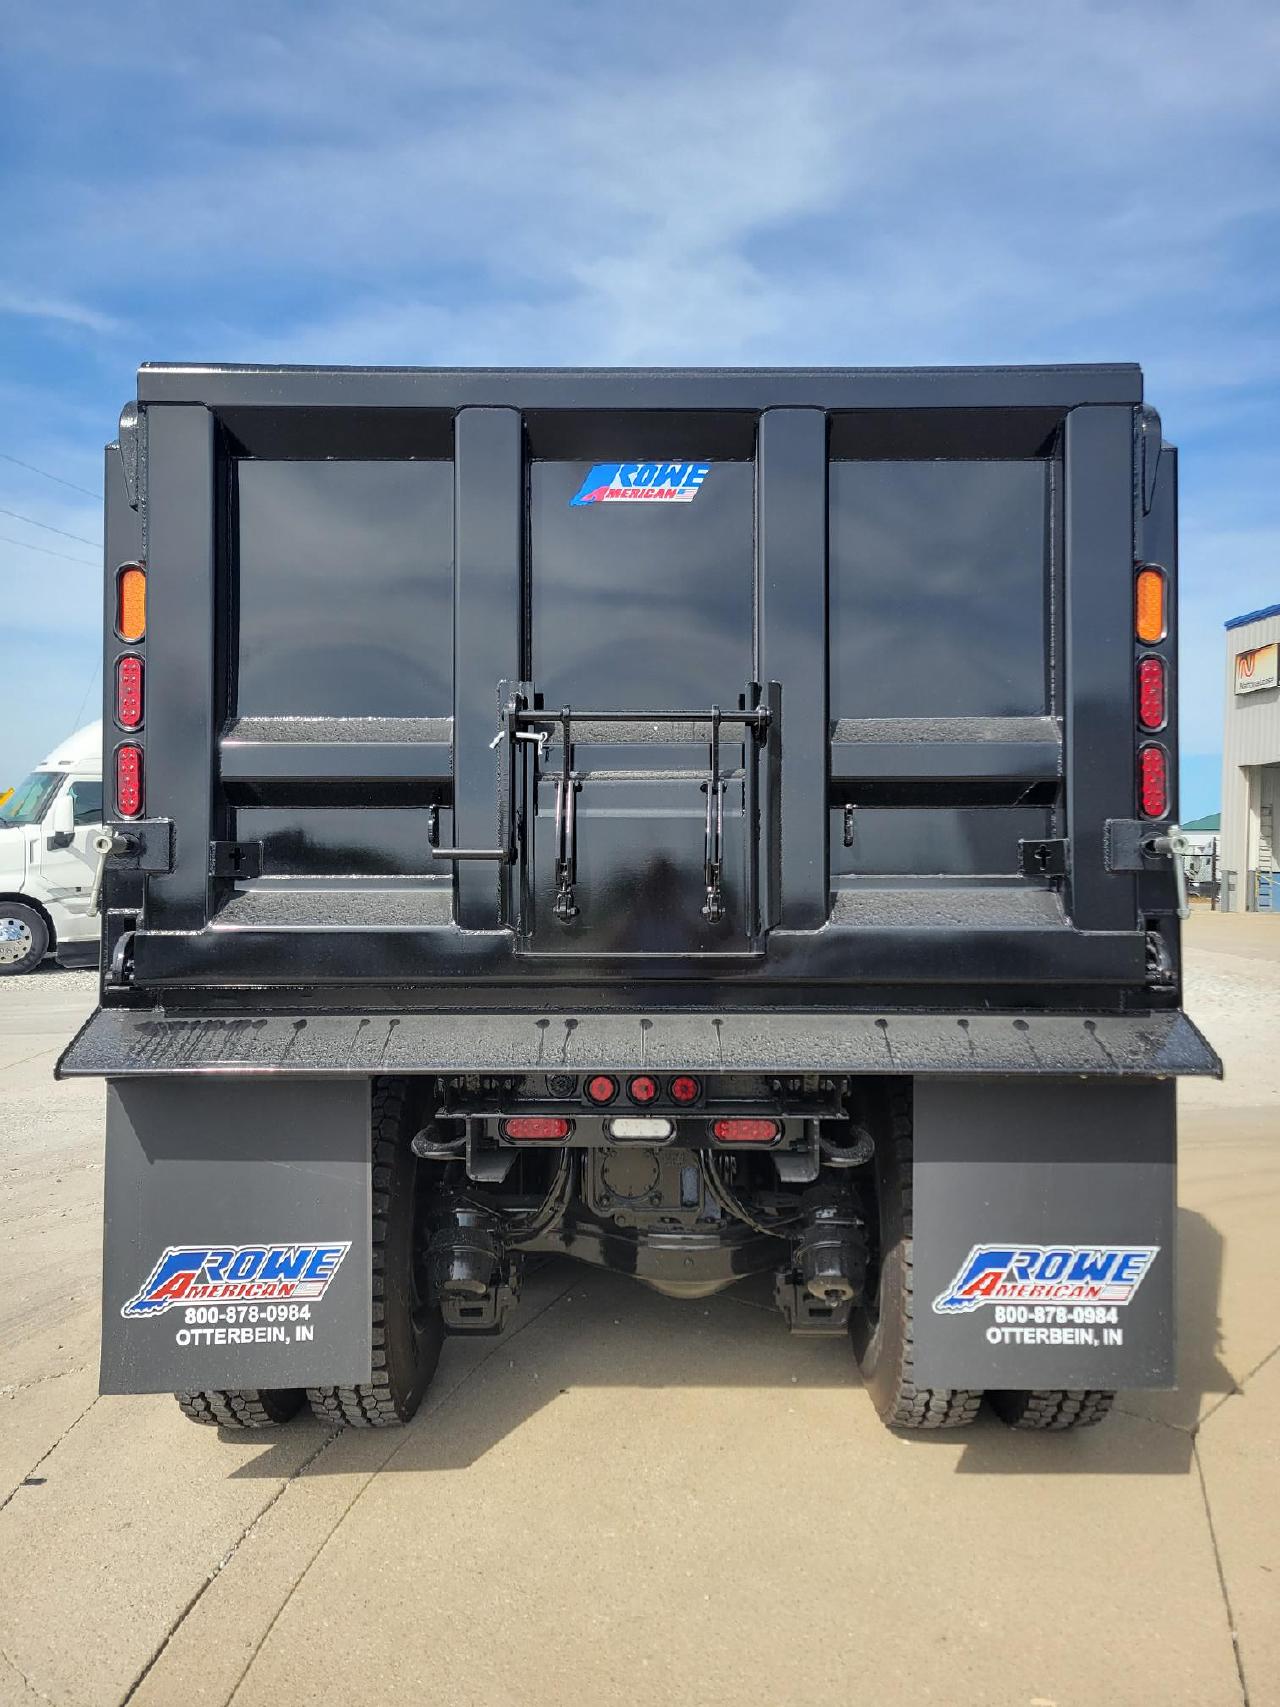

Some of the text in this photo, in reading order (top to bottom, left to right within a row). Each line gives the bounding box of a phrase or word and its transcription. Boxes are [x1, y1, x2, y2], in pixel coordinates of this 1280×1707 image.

[612, 463, 710, 488] ROWE
[581, 486, 677, 502] AMERICAN
[198, 1247, 344, 1282] ROWE
[1008, 1250, 1150, 1284] ROWE
[150, 1272, 296, 1300] AMERICAN
[961, 1271, 1102, 1298] AMERICAN
[184, 1305, 311, 1324] 800-878-0984
[994, 1306, 1118, 1324] 800-878-0984
[175, 1325, 314, 1346] OTTERBEIN, IN
[985, 1327, 1123, 1347] OTTERBEIN, IN
